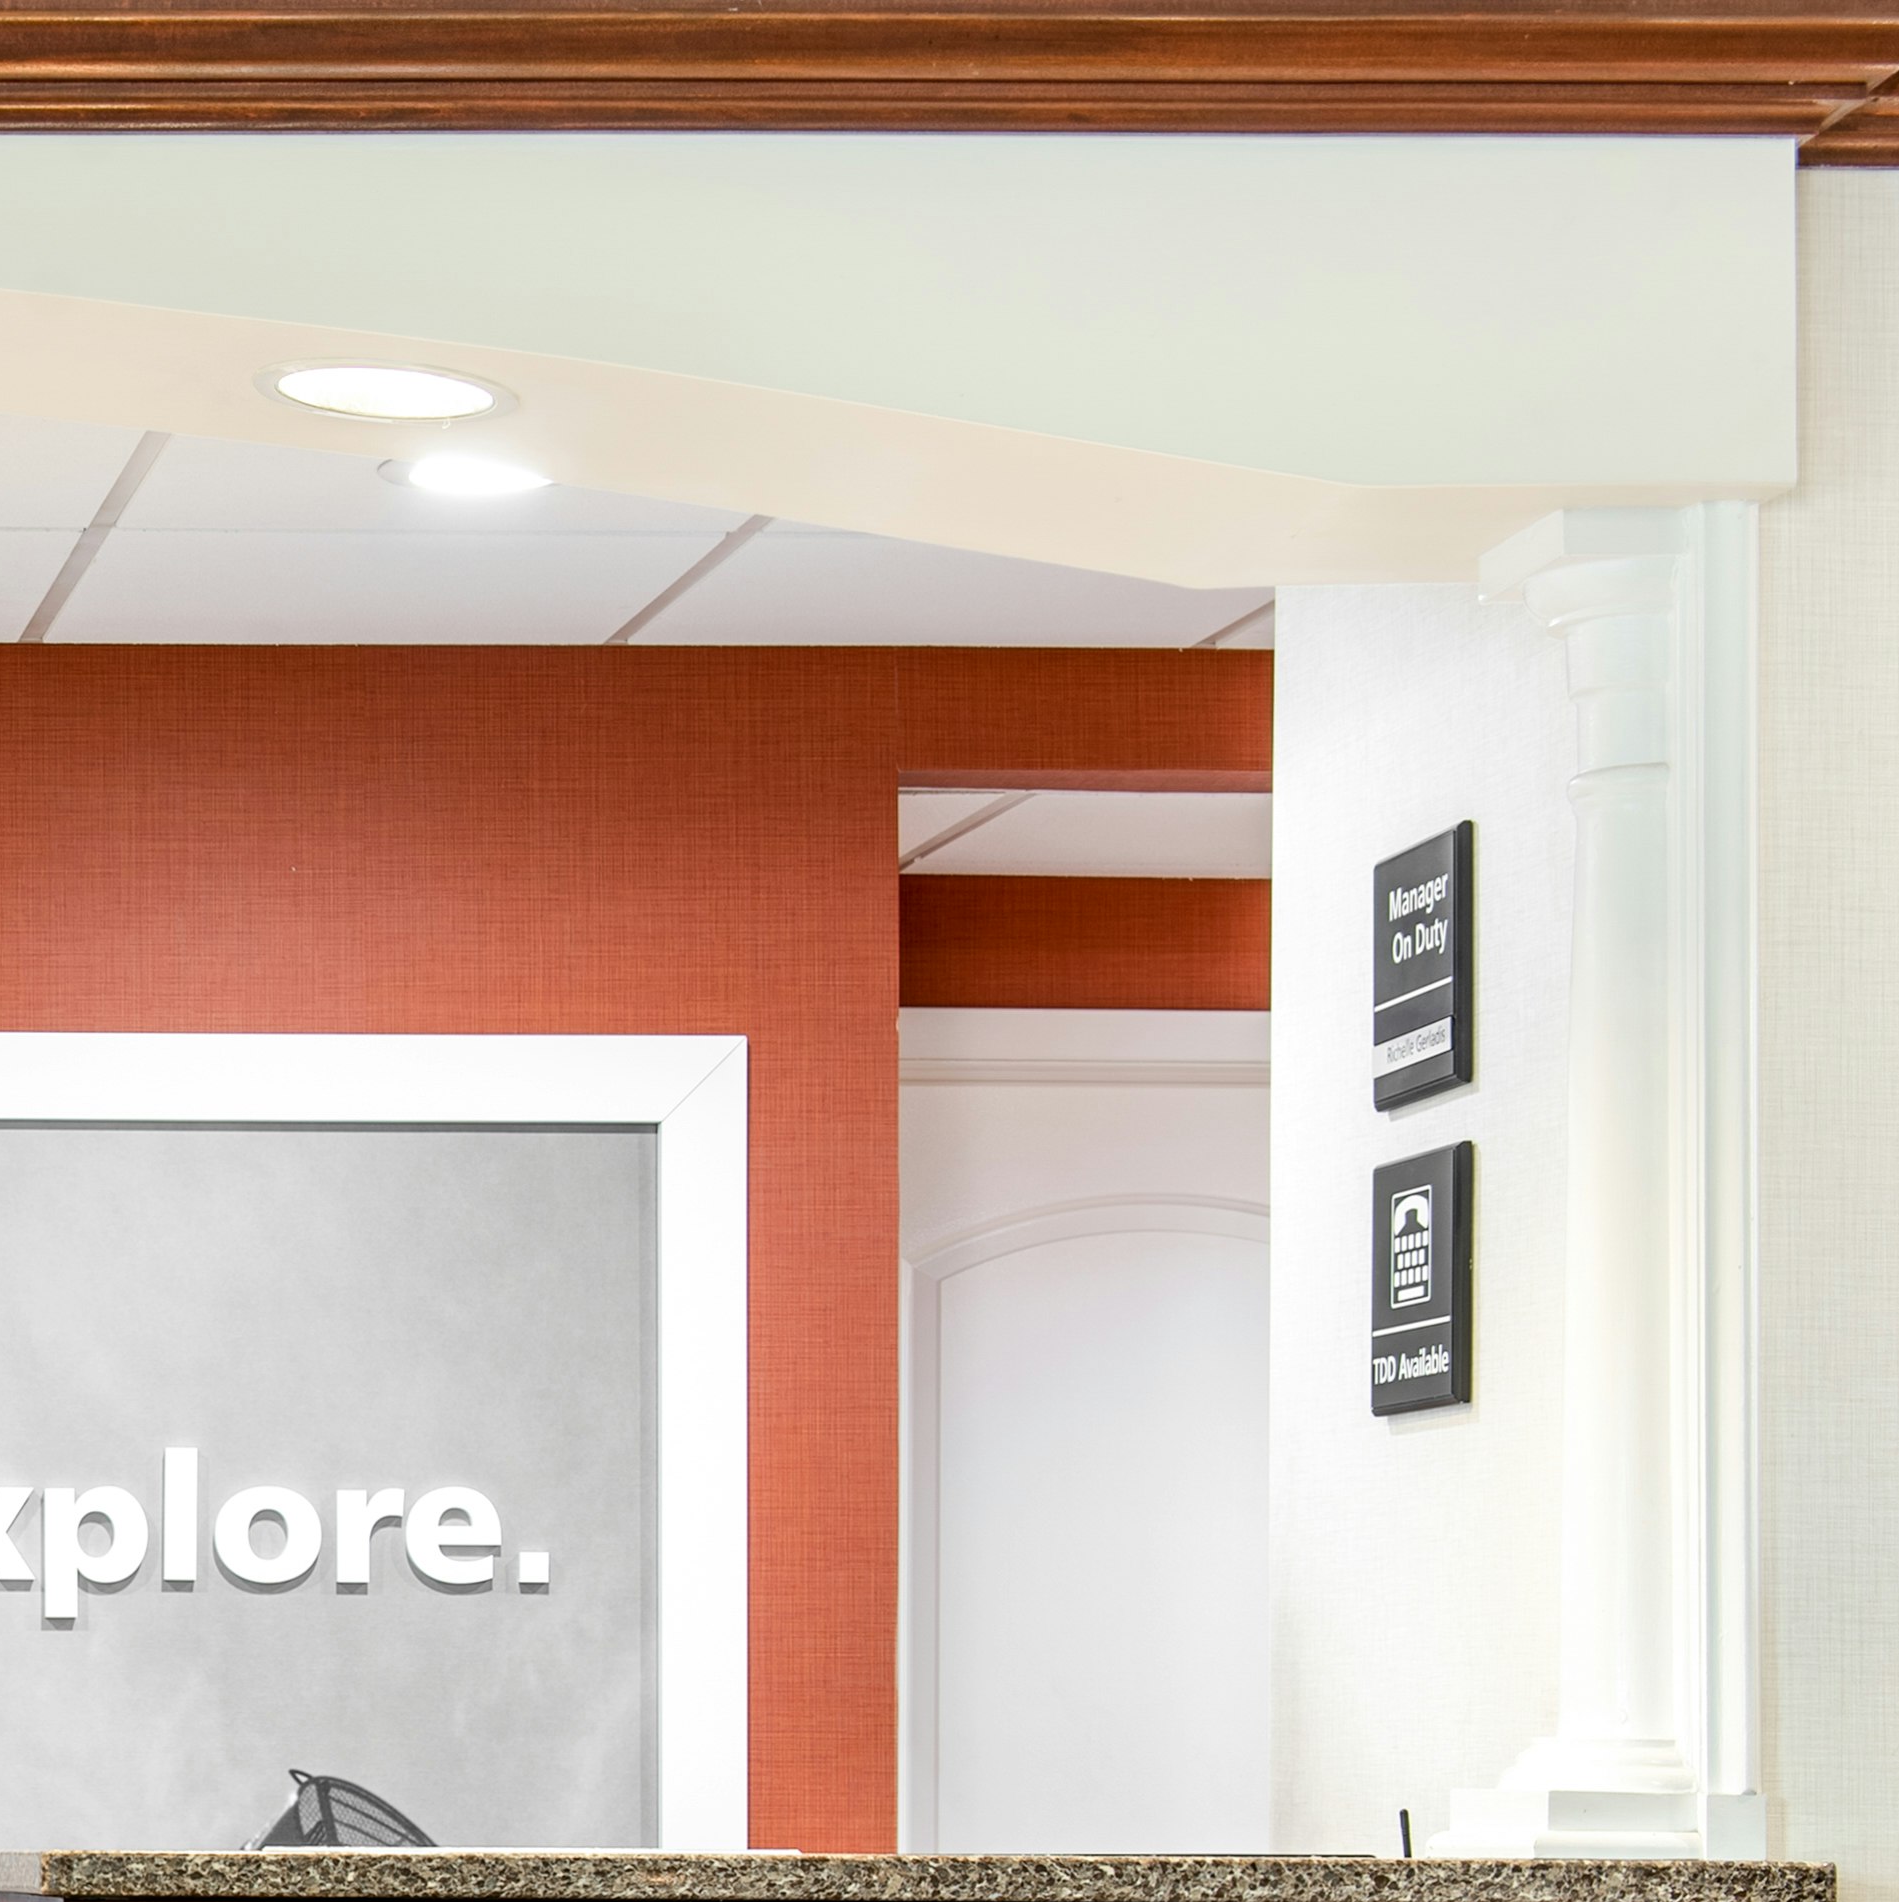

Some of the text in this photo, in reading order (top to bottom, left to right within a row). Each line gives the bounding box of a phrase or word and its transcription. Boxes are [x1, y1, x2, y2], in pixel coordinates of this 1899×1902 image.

[1388, 873, 1449, 922] Manager
[1392, 918, 1448, 964] On Duty
[1372, 1343, 1449, 1385] TDD Available
